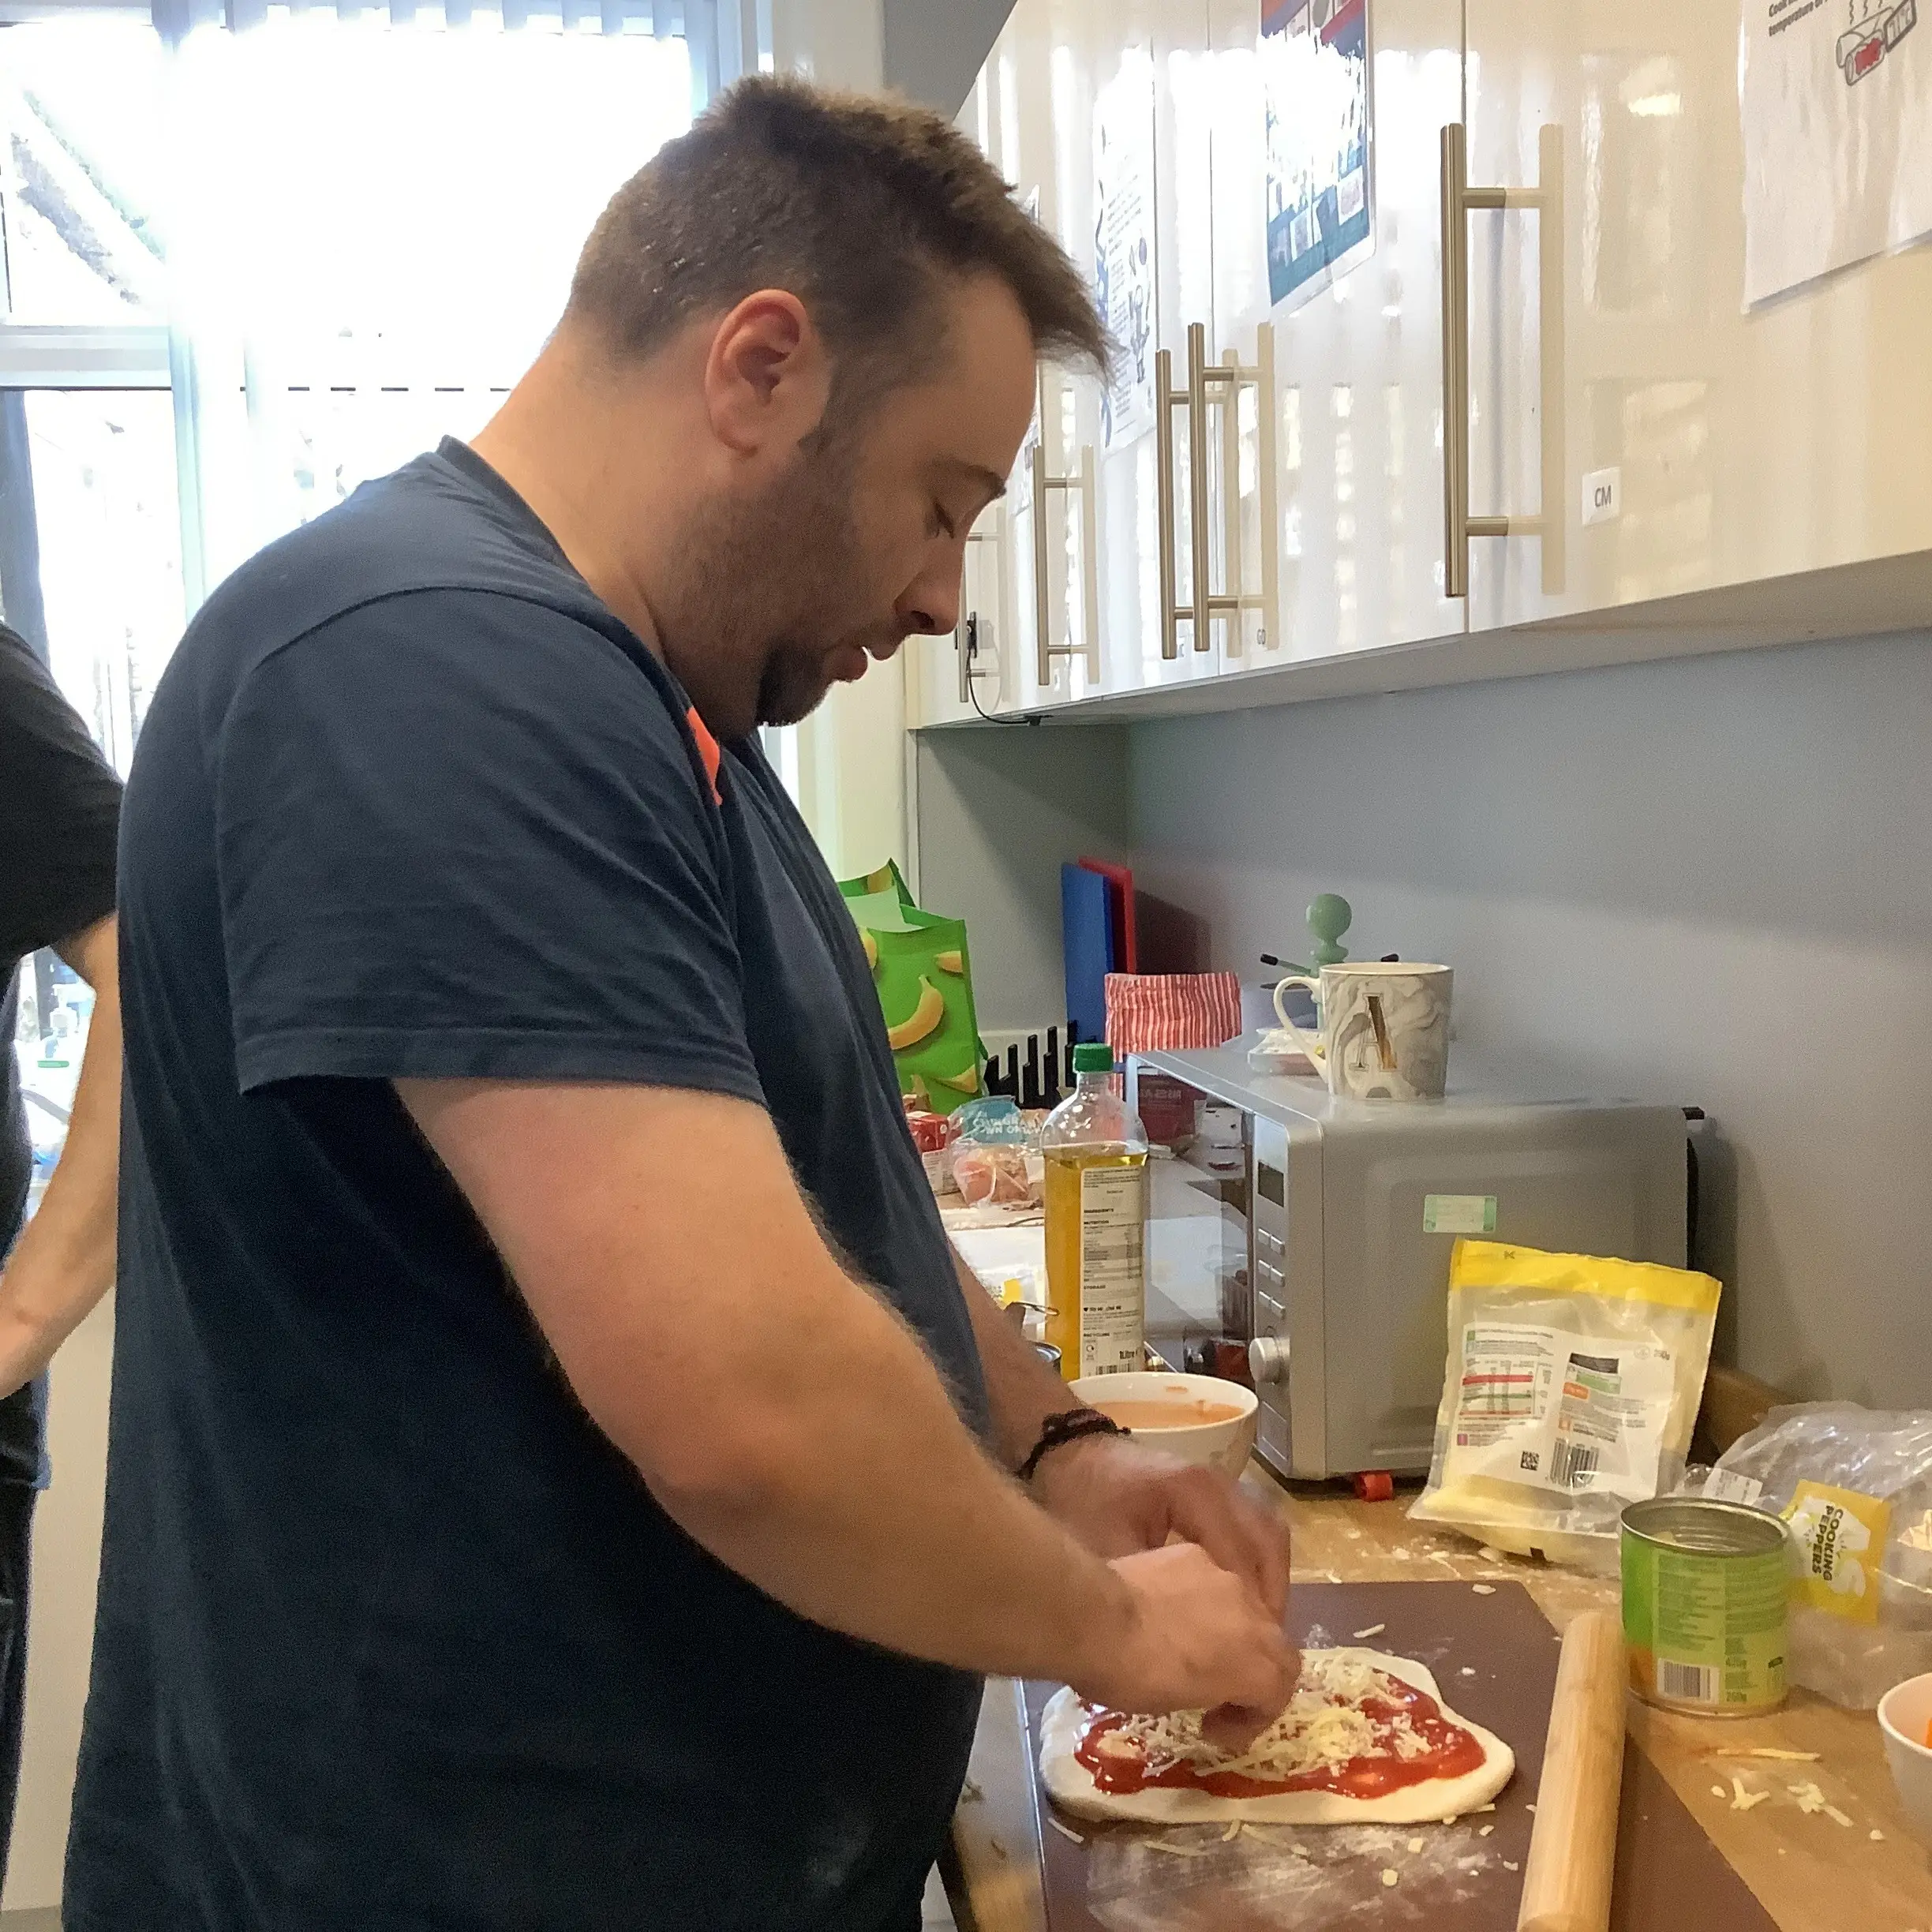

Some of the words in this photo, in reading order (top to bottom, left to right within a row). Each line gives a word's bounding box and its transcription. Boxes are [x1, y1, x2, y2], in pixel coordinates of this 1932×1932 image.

[1594, 485, 1612, 507] CM
[1812, 1505, 1835, 1574] PEPPERS
[1823, 1508, 1844, 1582] COOKING
